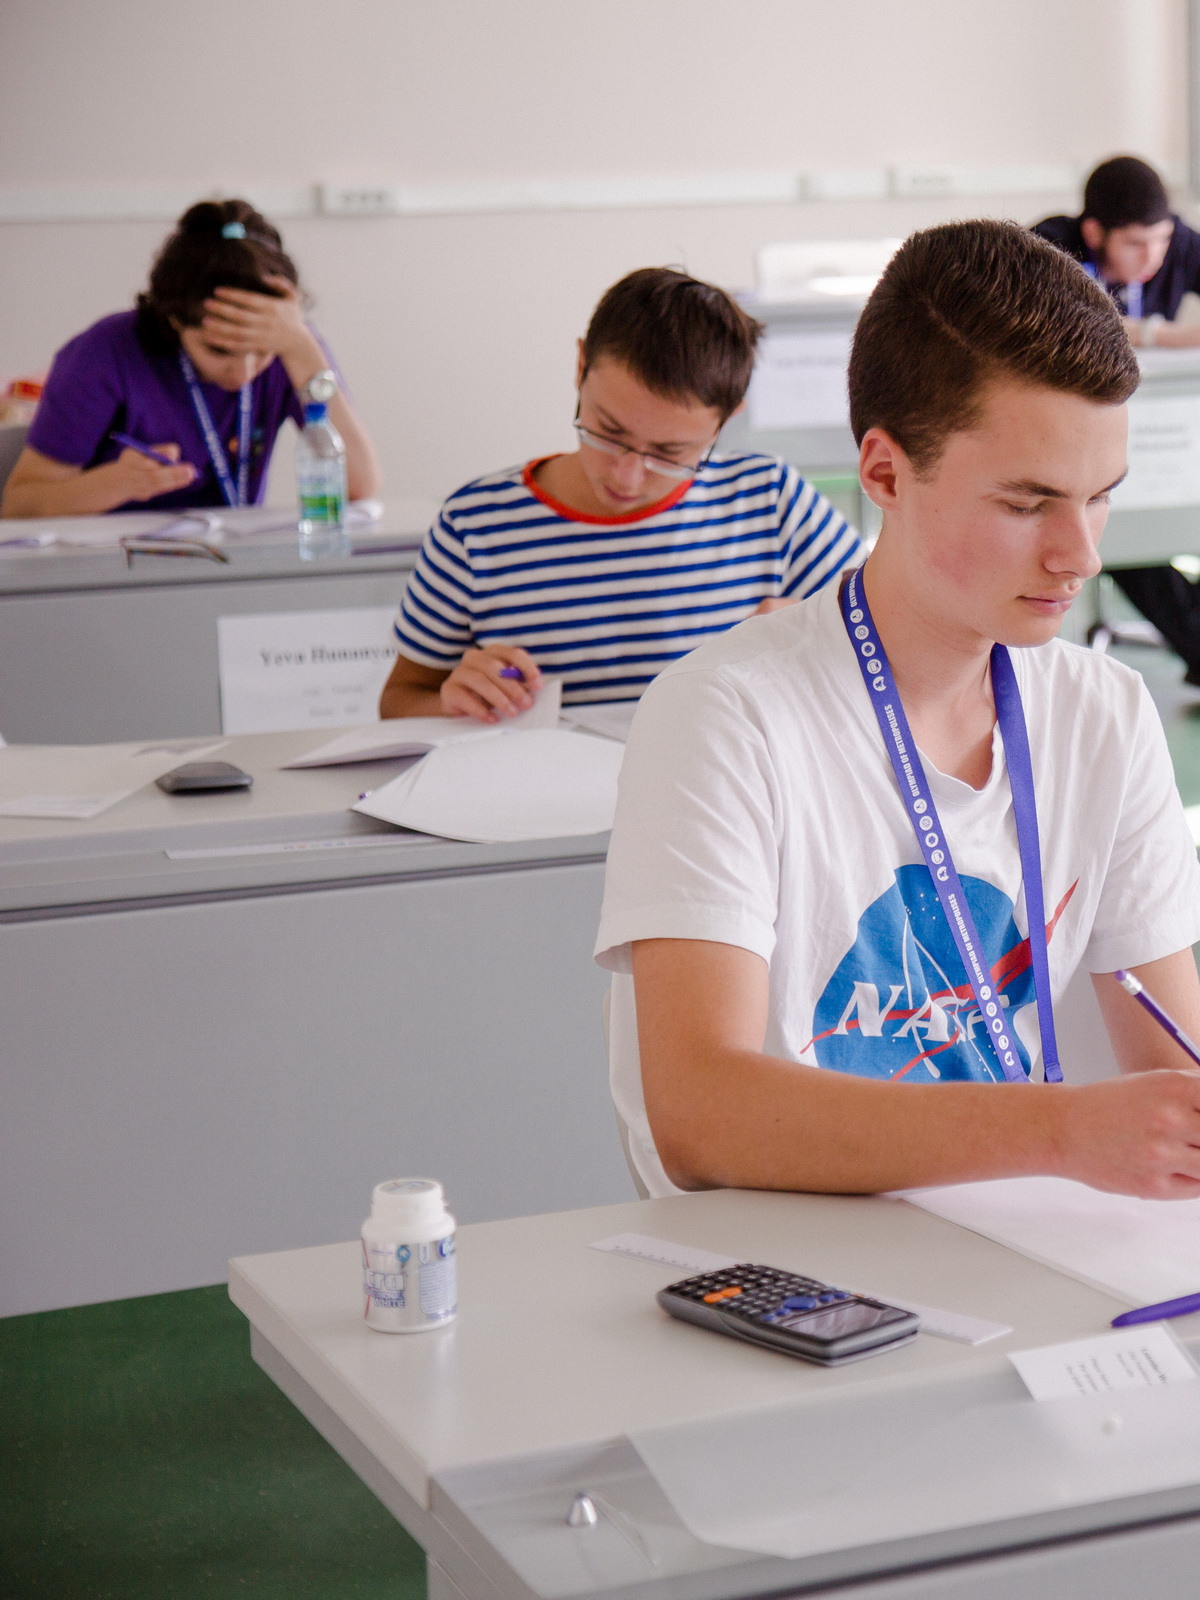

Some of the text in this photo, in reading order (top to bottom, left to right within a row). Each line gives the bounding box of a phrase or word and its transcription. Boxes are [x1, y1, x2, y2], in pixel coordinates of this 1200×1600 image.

[261, 650, 305, 666] Yeva
[884, 704, 920, 797] OLYMPIAD OF METROPOLISES
[948, 893, 985, 984] OLYMPIAD OF METROPOLISES
